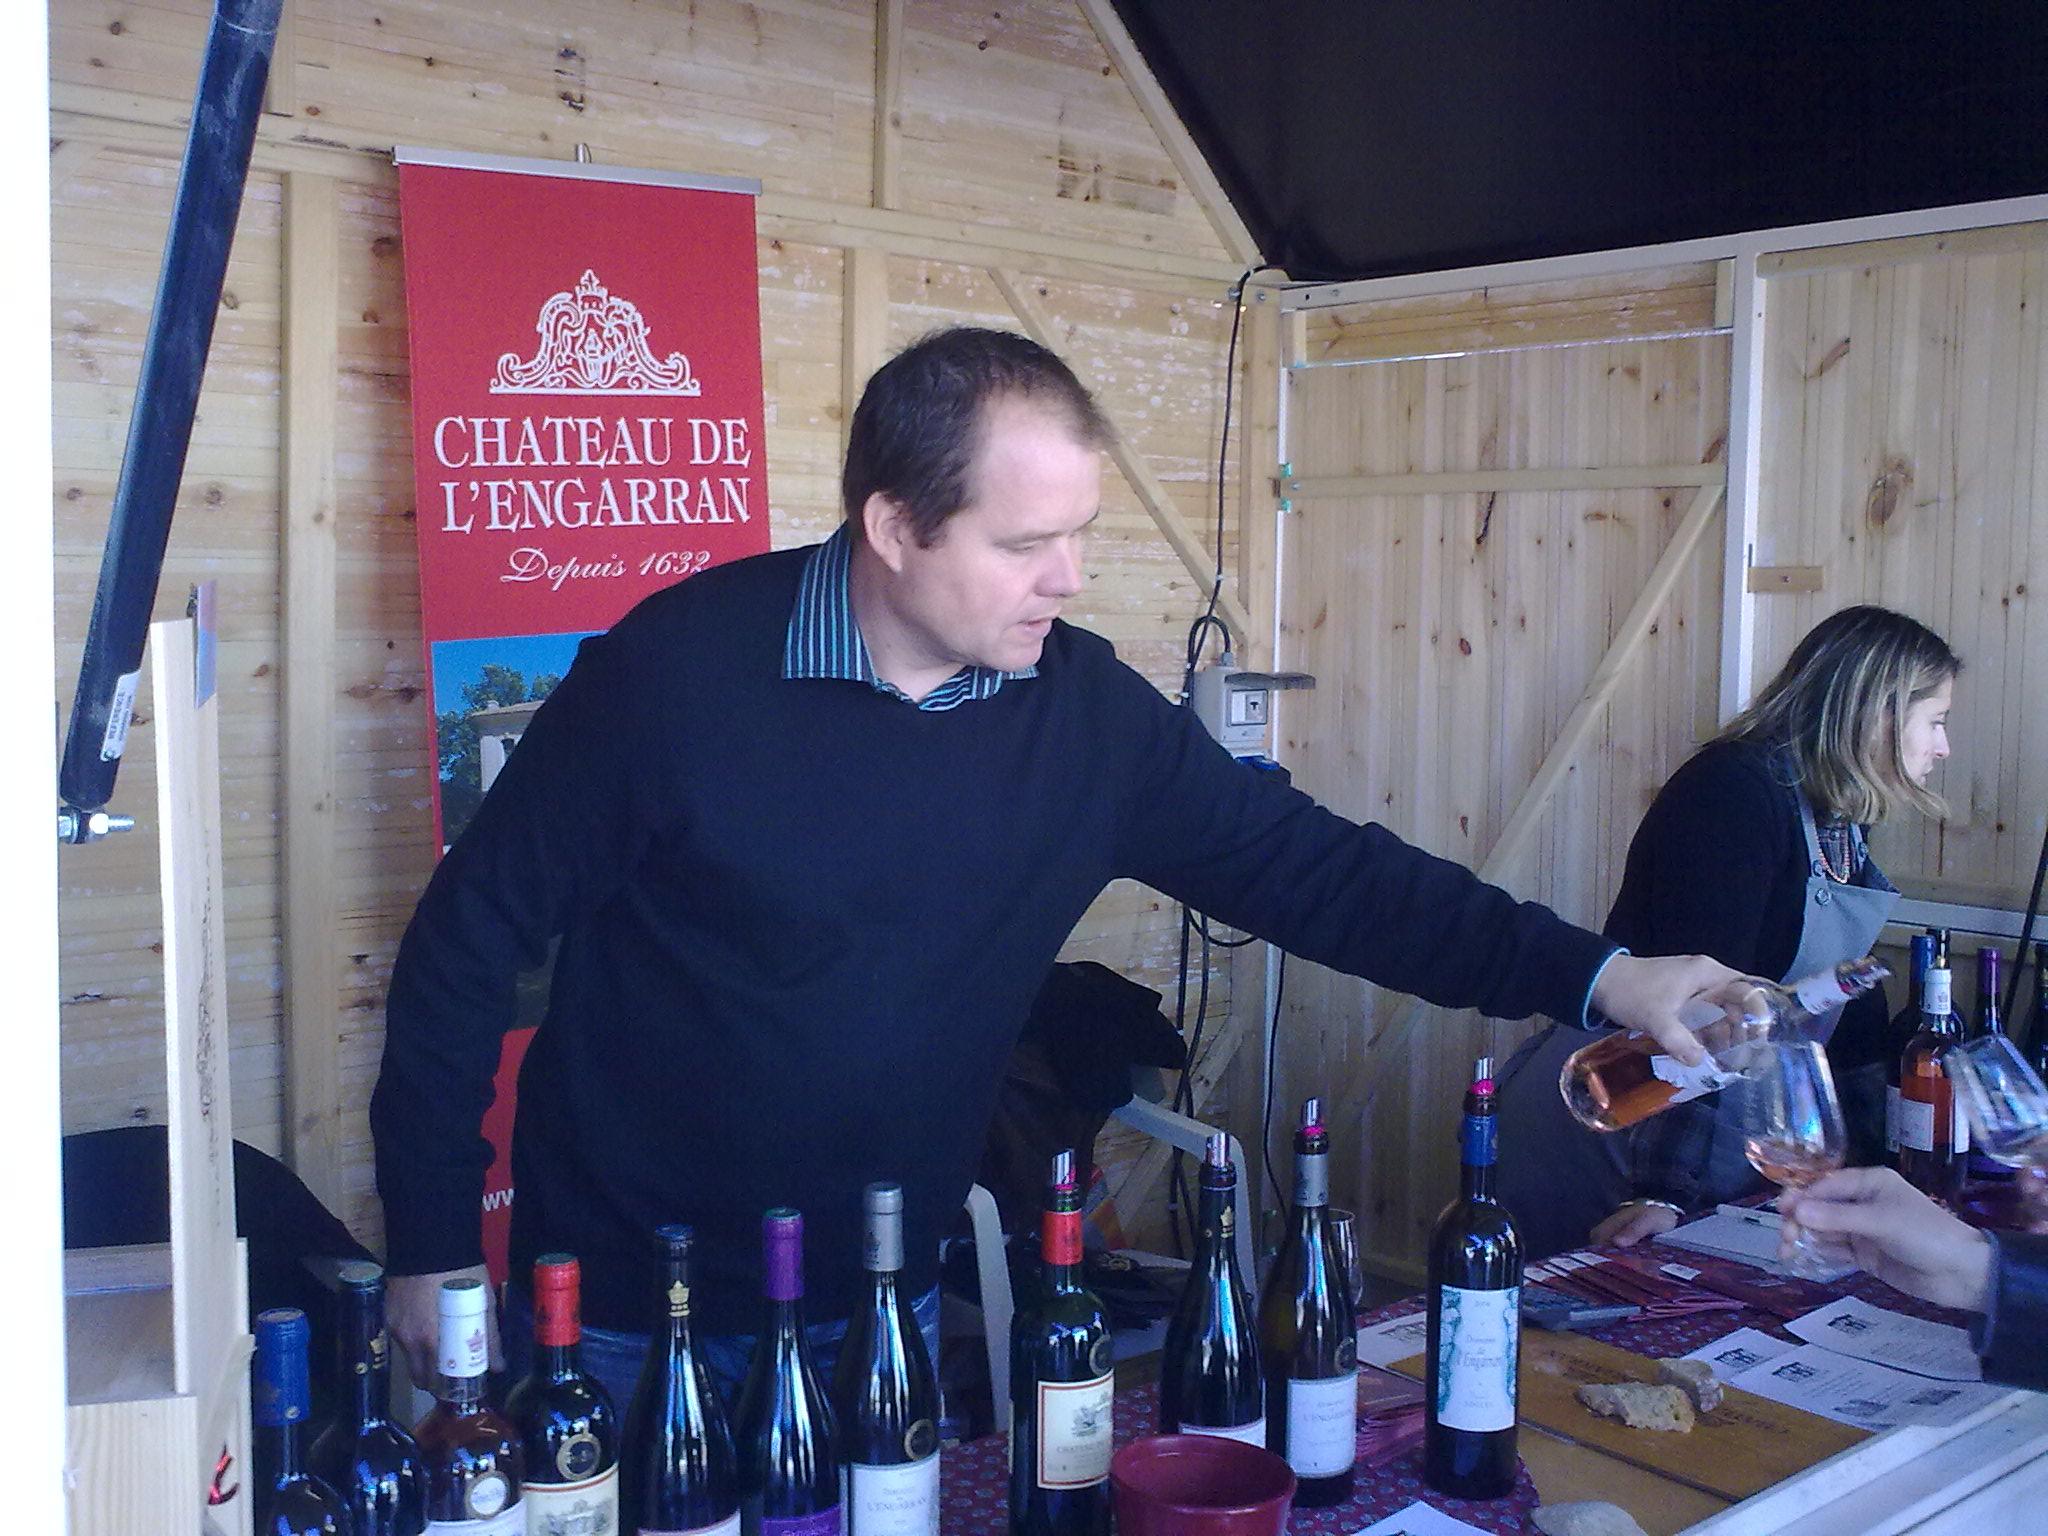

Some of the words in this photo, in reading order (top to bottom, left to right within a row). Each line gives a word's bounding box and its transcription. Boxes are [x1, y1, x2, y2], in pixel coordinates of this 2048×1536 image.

[433, 415, 673, 469] CHATEAU
[688, 416, 752, 468] DE
[439, 476, 751, 534] L'ENGARRAN
[500, 547, 627, 591] Depuis
[639, 550, 711, 575] 1632
